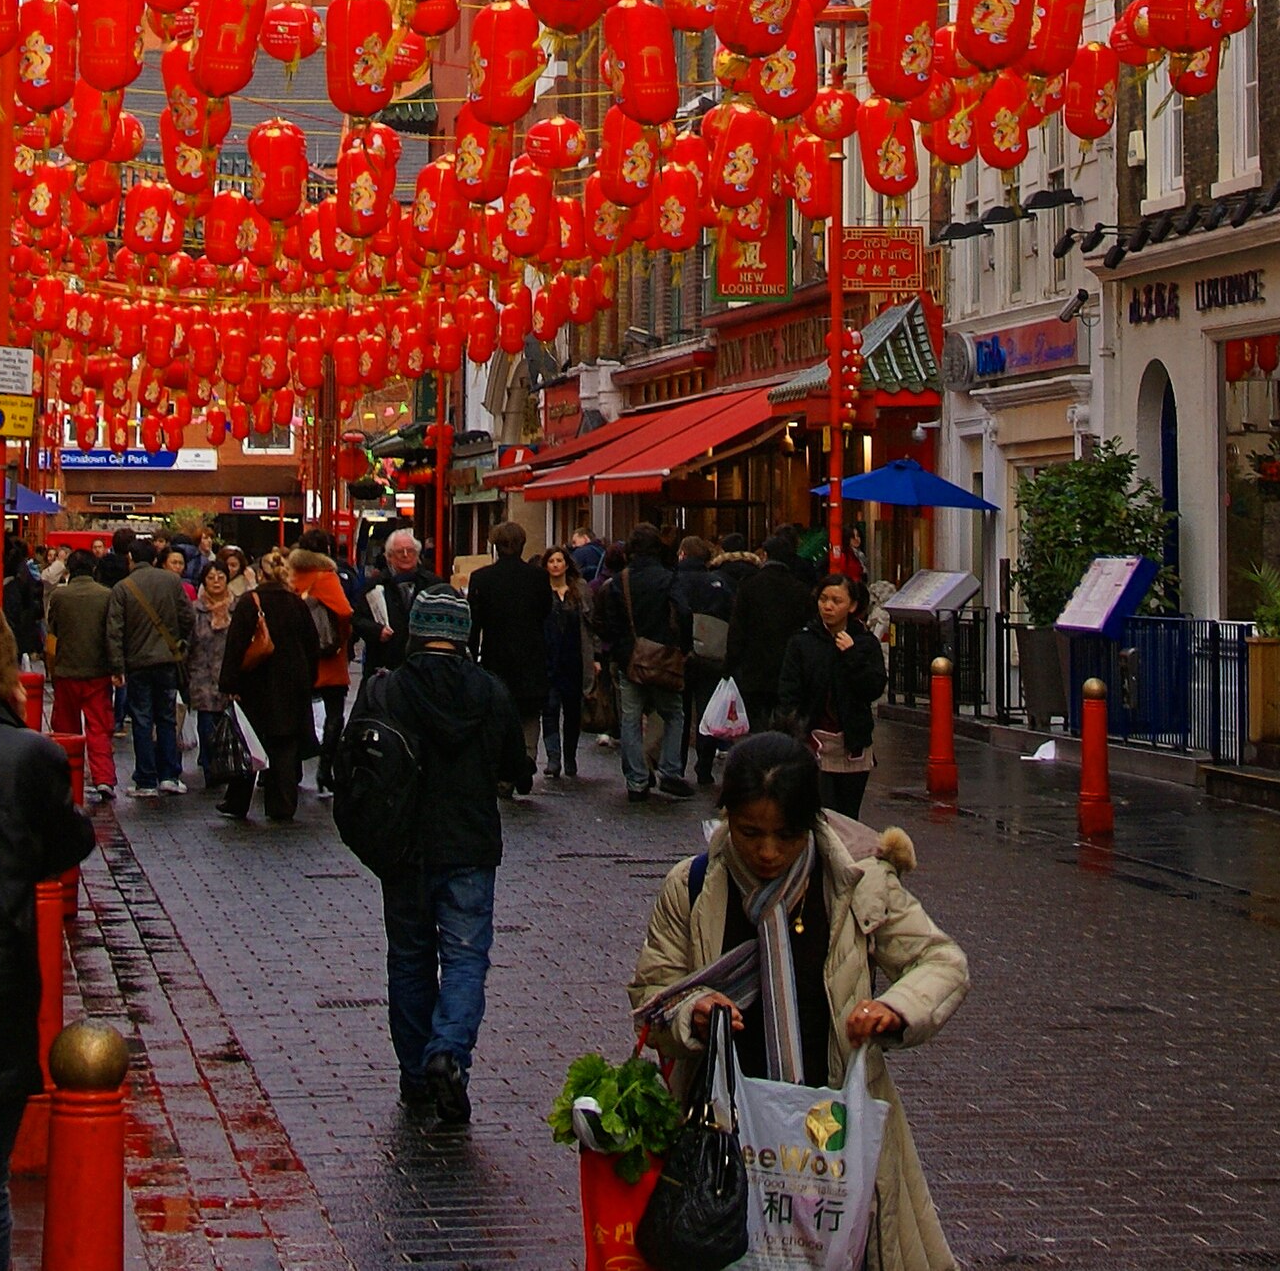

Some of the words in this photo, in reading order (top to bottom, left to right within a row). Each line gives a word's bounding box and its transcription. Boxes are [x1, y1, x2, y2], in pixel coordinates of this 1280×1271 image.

[740, 272, 764, 283] NEW
[721, 283, 753, 295] LOON
[755, 283, 785, 295] FUNG
[61, 454, 107, 464] Chinatown
[109, 454, 125, 464] Car
[127, 454, 149, 464] Park
[741, 1144, 848, 1178] eeWoo
